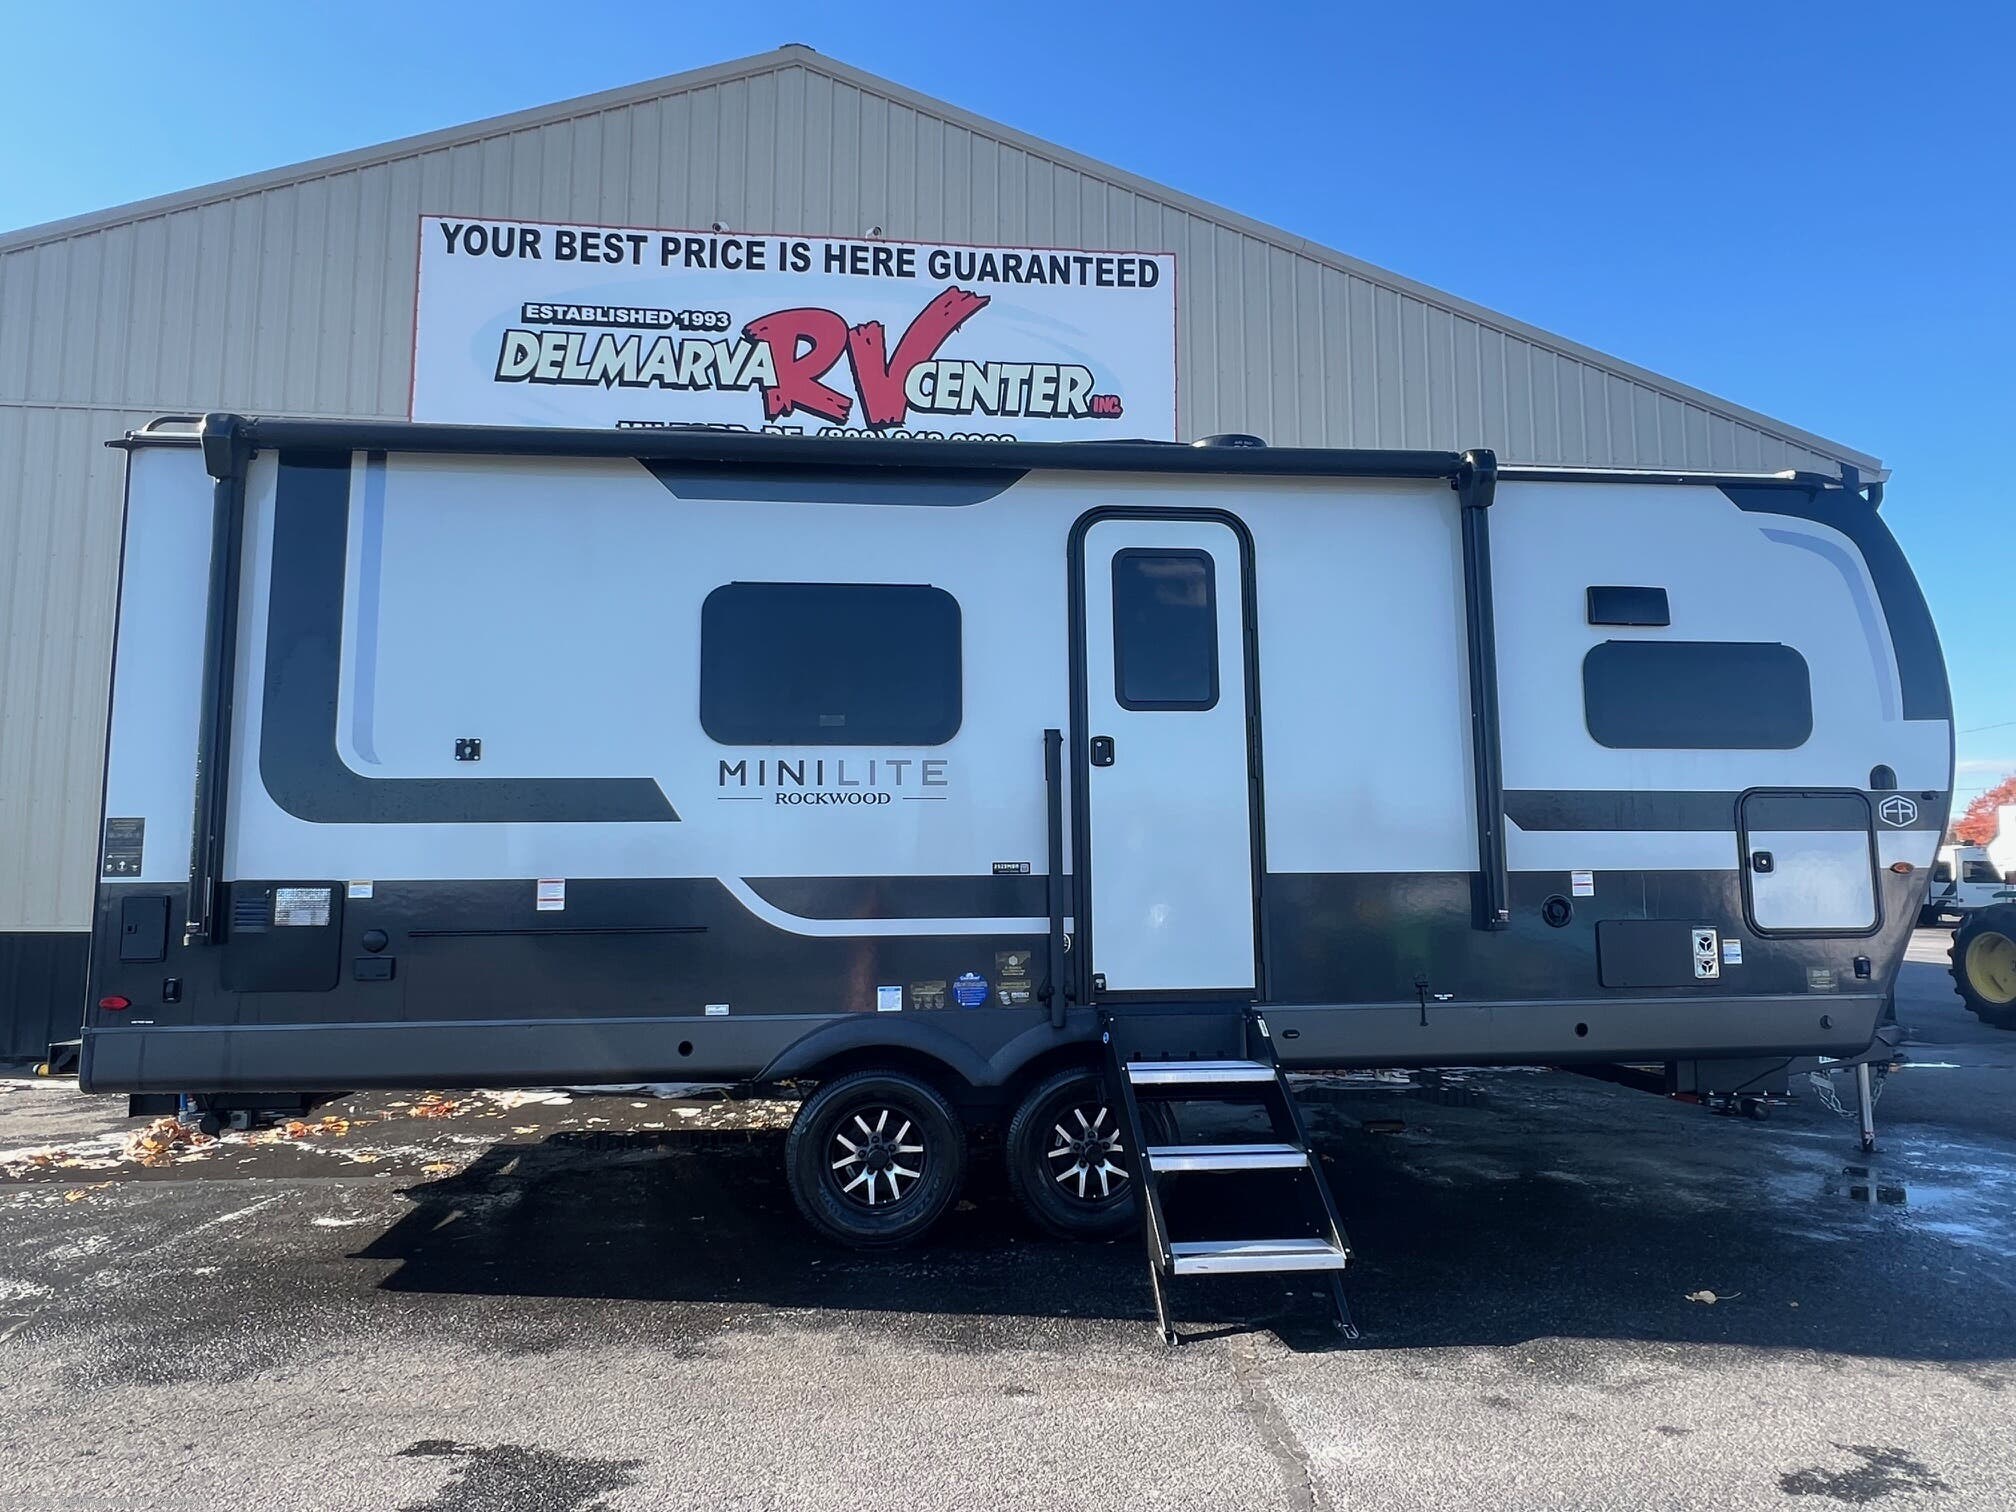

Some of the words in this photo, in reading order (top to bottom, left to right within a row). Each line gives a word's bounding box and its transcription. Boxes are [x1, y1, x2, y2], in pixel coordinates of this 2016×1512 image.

[440, 223, 542, 260] YOUR
[555, 230, 649, 265] BEST
[660, 236, 766, 270] PRICE
[779, 242, 811, 273] IS
[824, 243, 916, 278] HERE
[928, 250, 1160, 288] GUARANTEED
[525, 304, 675, 326] ESTABLISHED
[680, 311, 730, 328] 1993
[496, 329, 779, 390] DELMARVA
[741, 286, 991, 428] RV
[904, 360, 1094, 418] CENTER
[775, 792, 891, 805] ROCKWOOD
